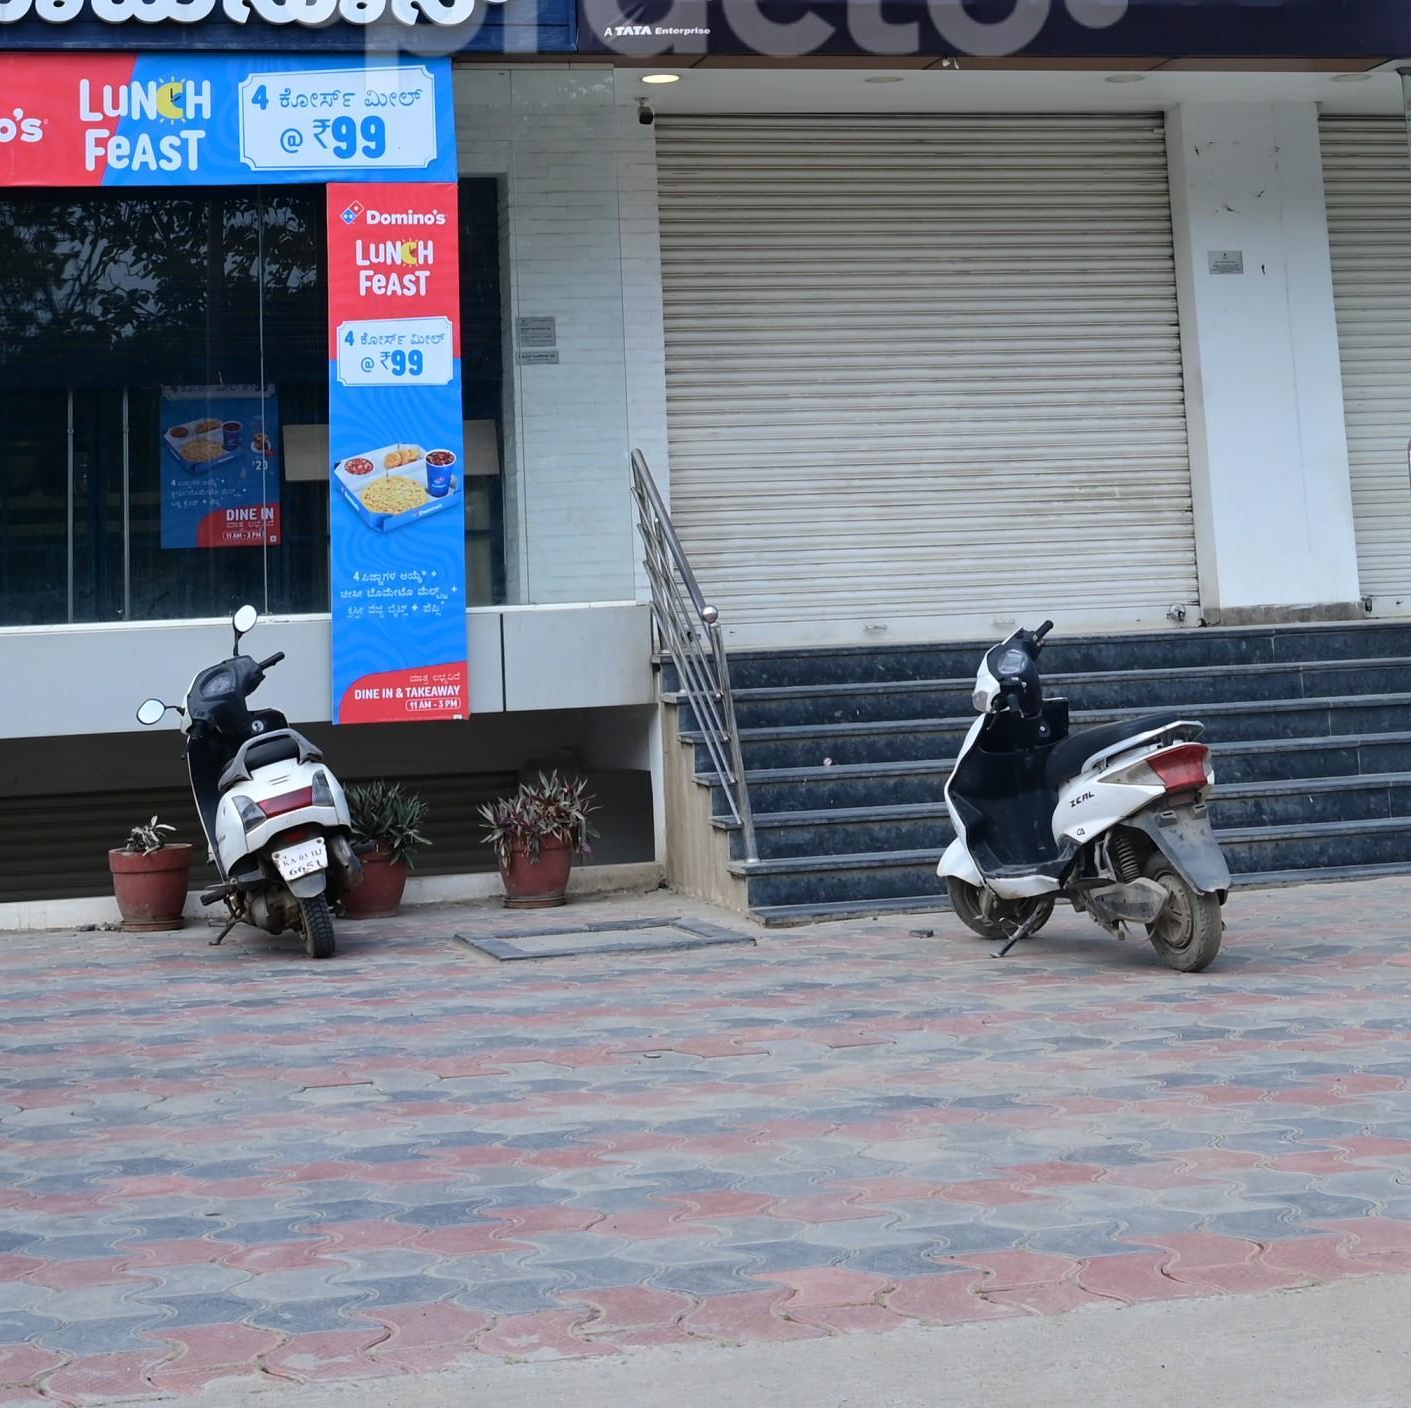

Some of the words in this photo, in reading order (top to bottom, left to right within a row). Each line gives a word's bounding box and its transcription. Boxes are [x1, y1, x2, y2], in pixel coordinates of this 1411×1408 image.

[603, 27, 613, 37] A
[615, 25, 652, 36] TATA
[655, 27, 711, 36] Enterprise
[251, 84, 269, 110] 4
[280, 128, 303, 153] @
[312, 115, 386, 159] ₹99
[366, 209, 446, 225] Domino's
[344, 331, 354, 346] 4
[360, 356, 375, 373] @
[380, 349, 424, 376] ₹99
[226, 508, 257, 521] DINE
[353, 571, 359, 581] 4
[354, 688, 380, 700] DINE
[382, 688, 393, 698] IN
[396, 687, 403, 698] &
[405, 684, 460, 698] TAKEAWAY
[409, 701, 418, 709] 11
[419, 700, 431, 709] AM
[445, 699, 458, 708] PM
